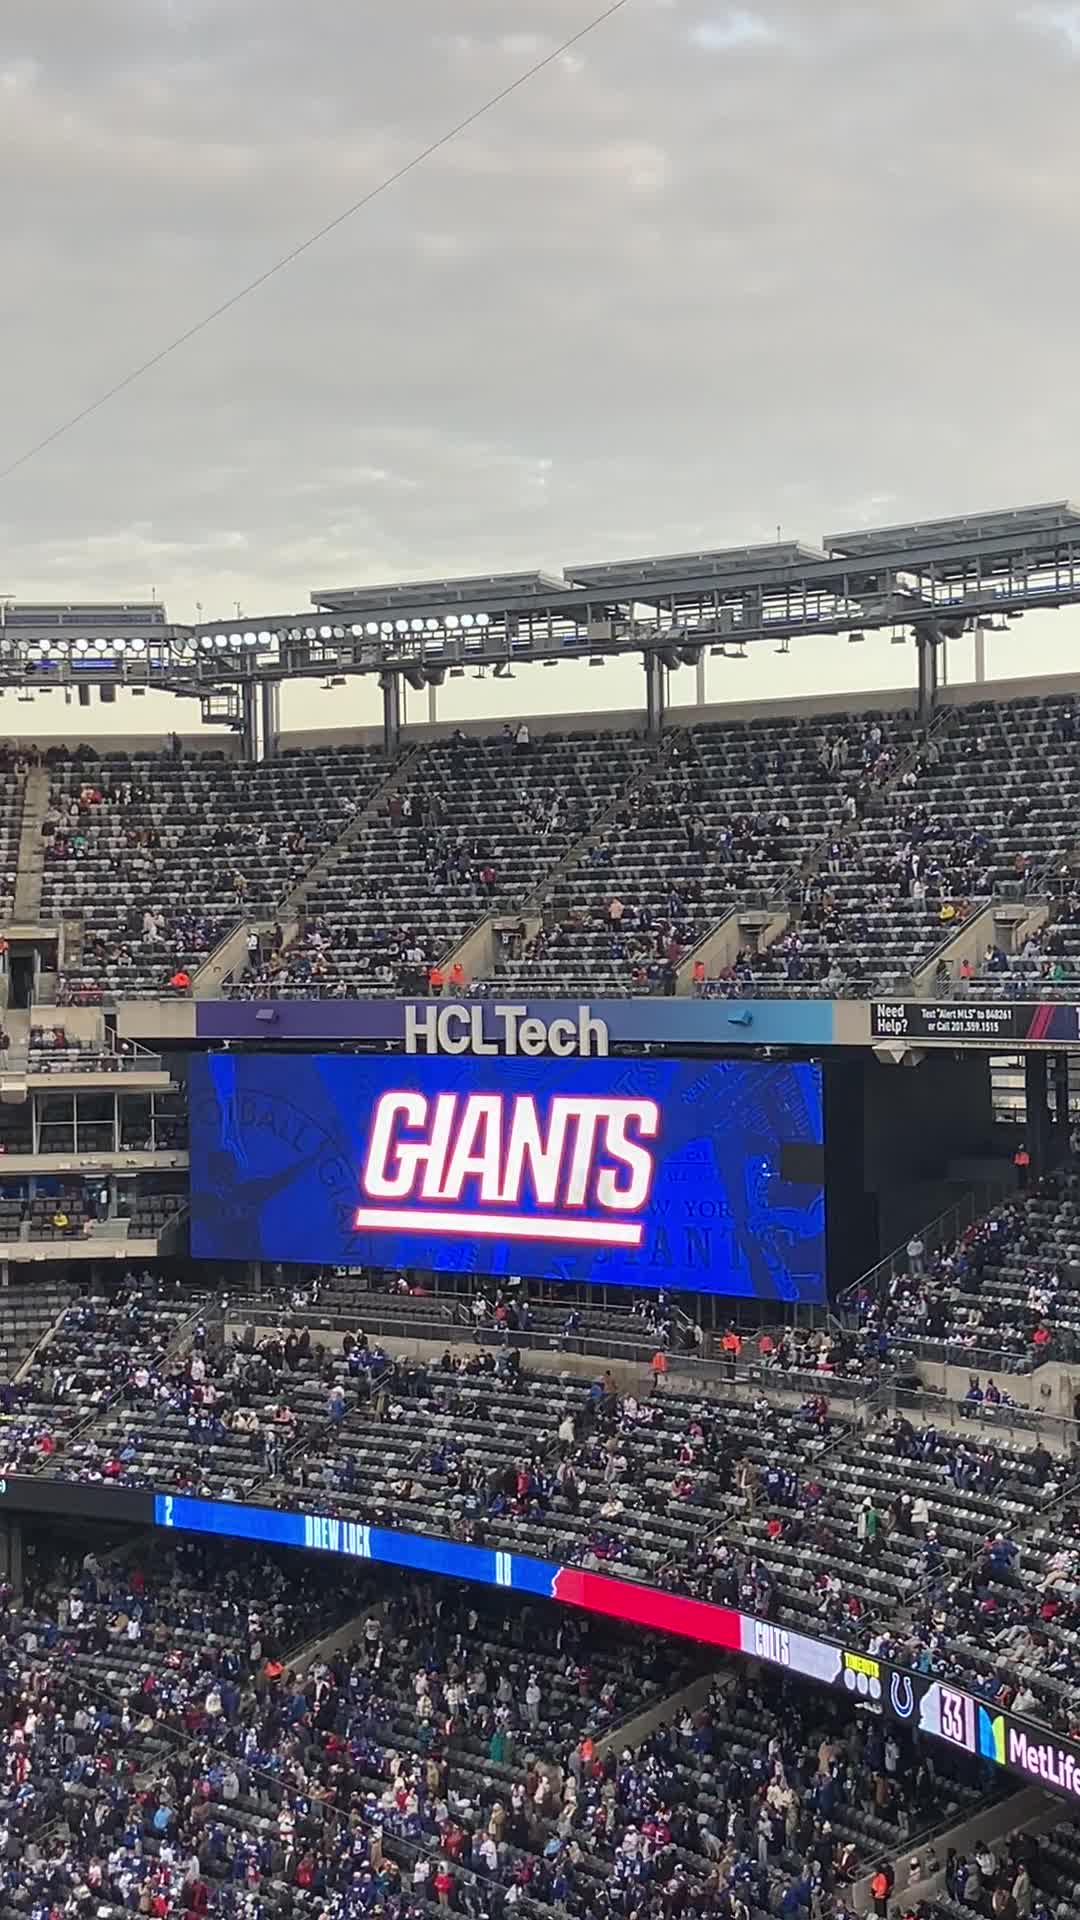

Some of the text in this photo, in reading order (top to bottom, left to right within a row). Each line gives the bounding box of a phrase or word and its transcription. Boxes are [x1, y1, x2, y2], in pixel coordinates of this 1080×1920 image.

[404, 1003, 610, 1058] HCLTech
[877, 1003, 905, 1018] Need
[877, 1018, 909, 1036] Help?
[928, 1022, 936, 1031] or
[936, 1021, 951, 1032] Call
[361, 1088, 660, 1213] GIANTS
[165, 1495, 174, 1526] 2
[304, 1514, 372, 1558] DREW LOCK
[754, 1620, 790, 1666] COLTS
[940, 1687, 963, 1742] 33
[1009, 1727, 1080, 1796] MetLife
